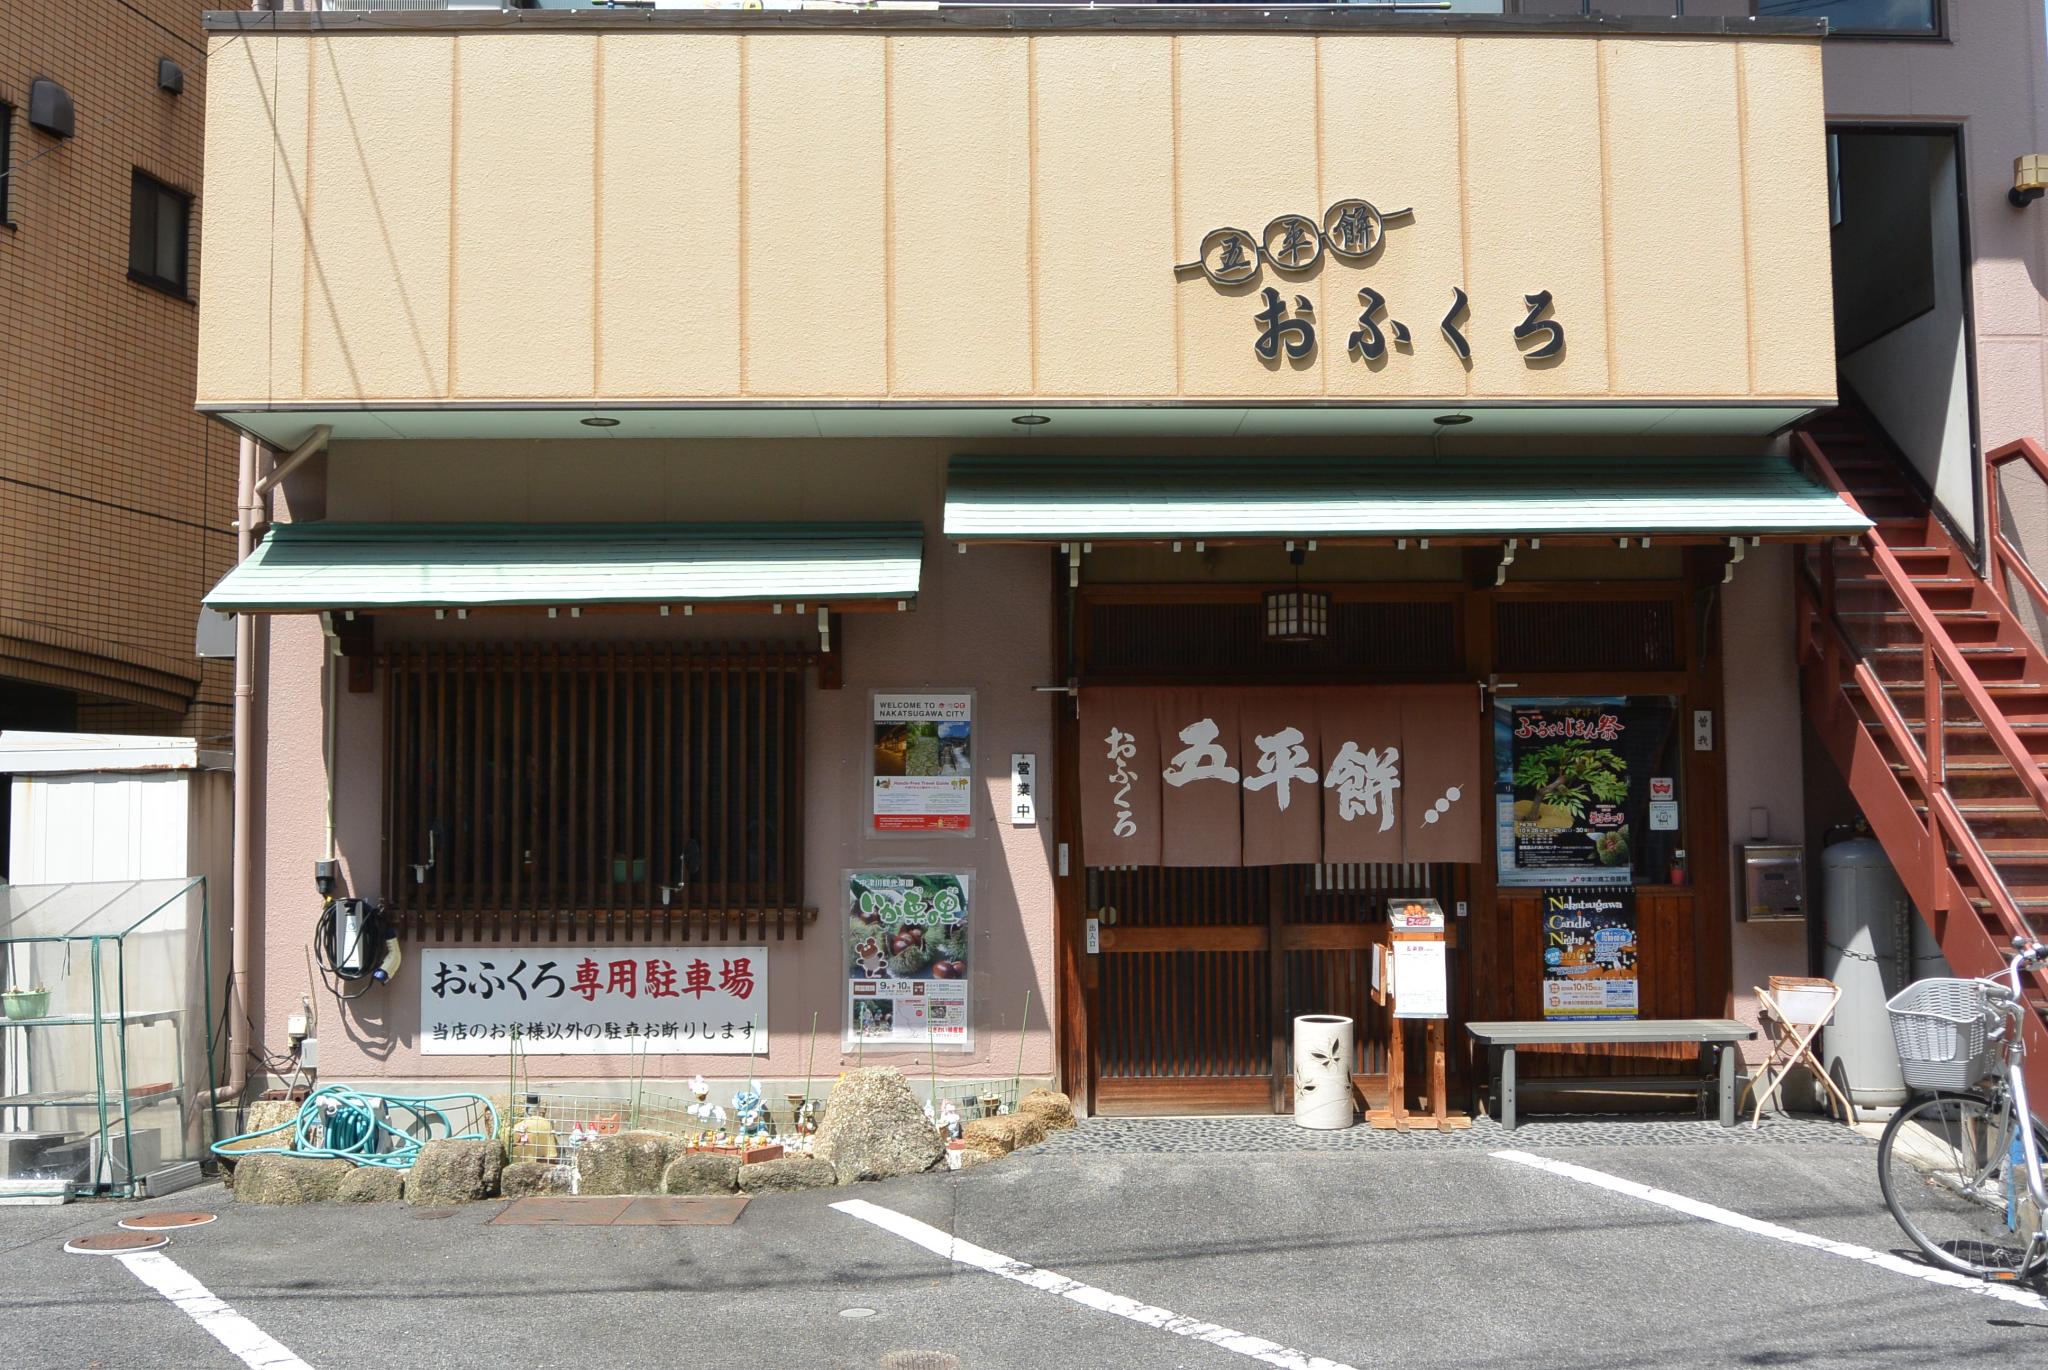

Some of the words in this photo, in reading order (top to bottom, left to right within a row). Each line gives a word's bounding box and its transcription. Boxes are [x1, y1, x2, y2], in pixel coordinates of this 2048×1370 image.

[1213, 205, 1374, 275] 五平餅
[1253, 286, 1564, 361] おふくろ
[1017, 762, 1030, 818] 営業中
[1104, 726, 1138, 838] おふくろ
[1162, 718, 1401, 833] 五平餅
[1548, 896, 1623, 912] Nakatsugawa
[1548, 915, 1591, 929] Candle
[1088, 925, 1097, 947] 出入口
[431, 957, 756, 1001] おふくろ専用駐車場
[432, 1021, 756, 1041] 当店のお客様以外の駐車お断りします
